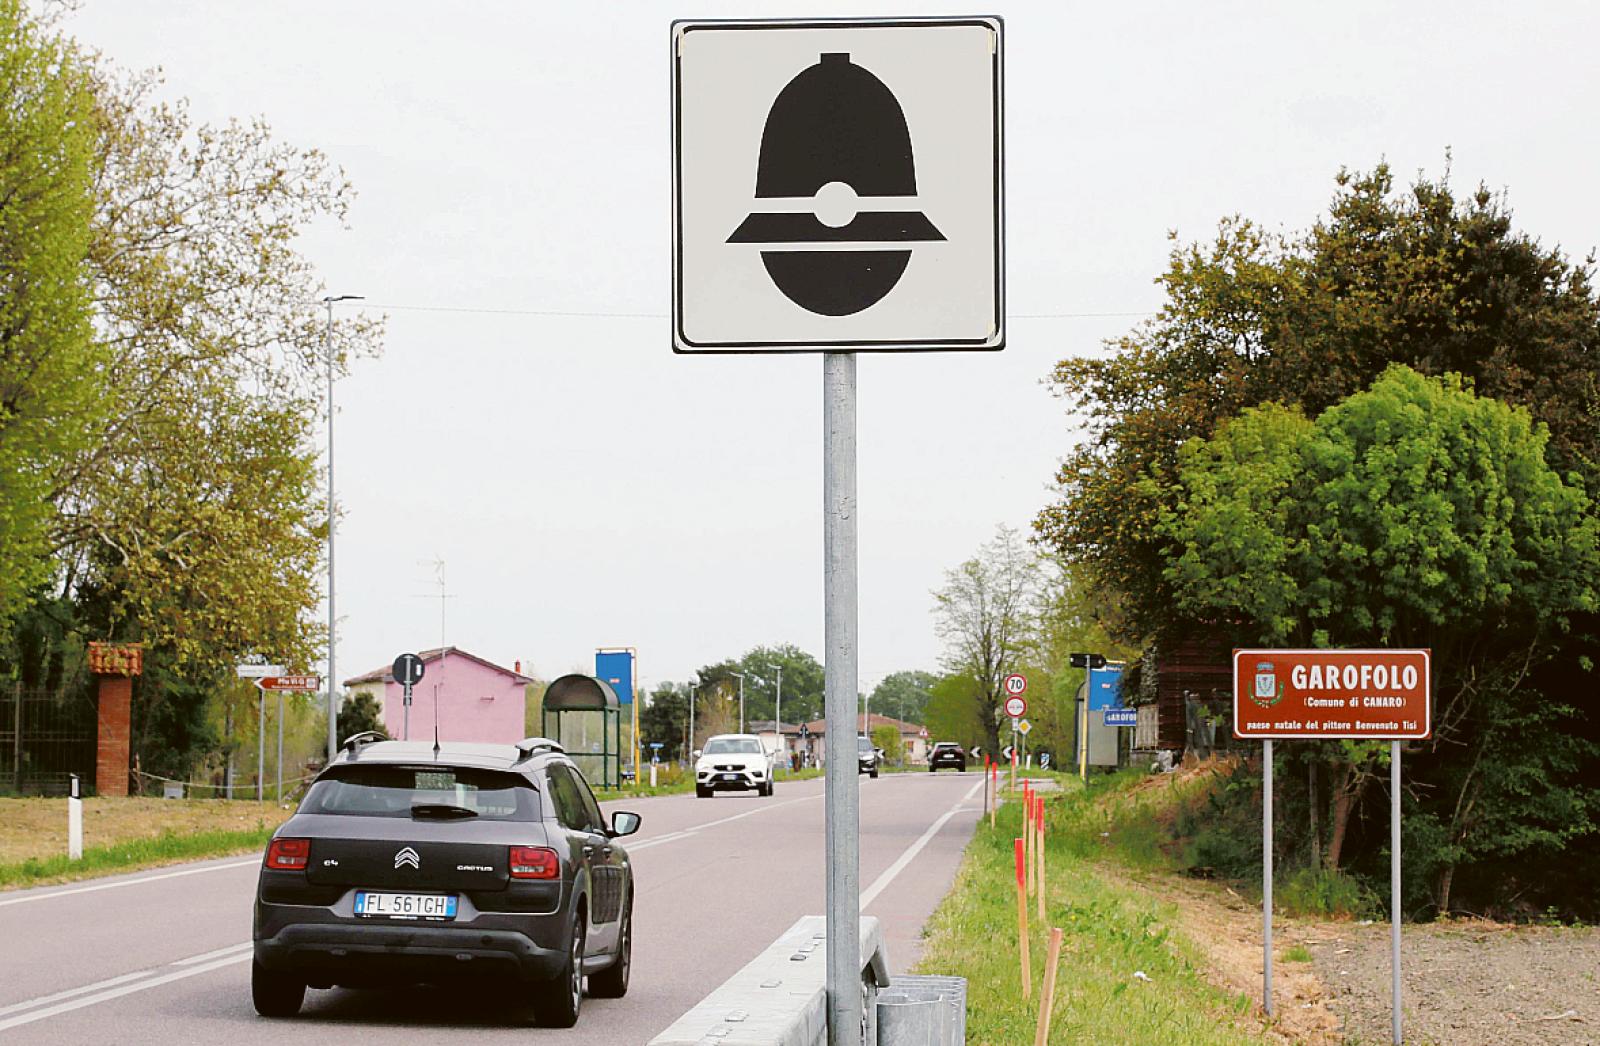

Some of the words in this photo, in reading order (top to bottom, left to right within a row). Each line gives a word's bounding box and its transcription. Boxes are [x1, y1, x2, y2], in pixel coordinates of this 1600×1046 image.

[1291, 664, 1418, 690] GAROFOLO
[1010, 679, 1023, 690] 70
[1349, 696, 1359, 707] di
[1246, 721, 1271, 731] paese
[1274, 720, 1302, 730] natale
[1305, 720, 1319, 730] del
[1322, 720, 1351, 731] pittore
[1355, 720, 1399, 730] Benvenuto
[1402, 720, 1417, 730] Tisi
[367, 894, 385, 911] FL
